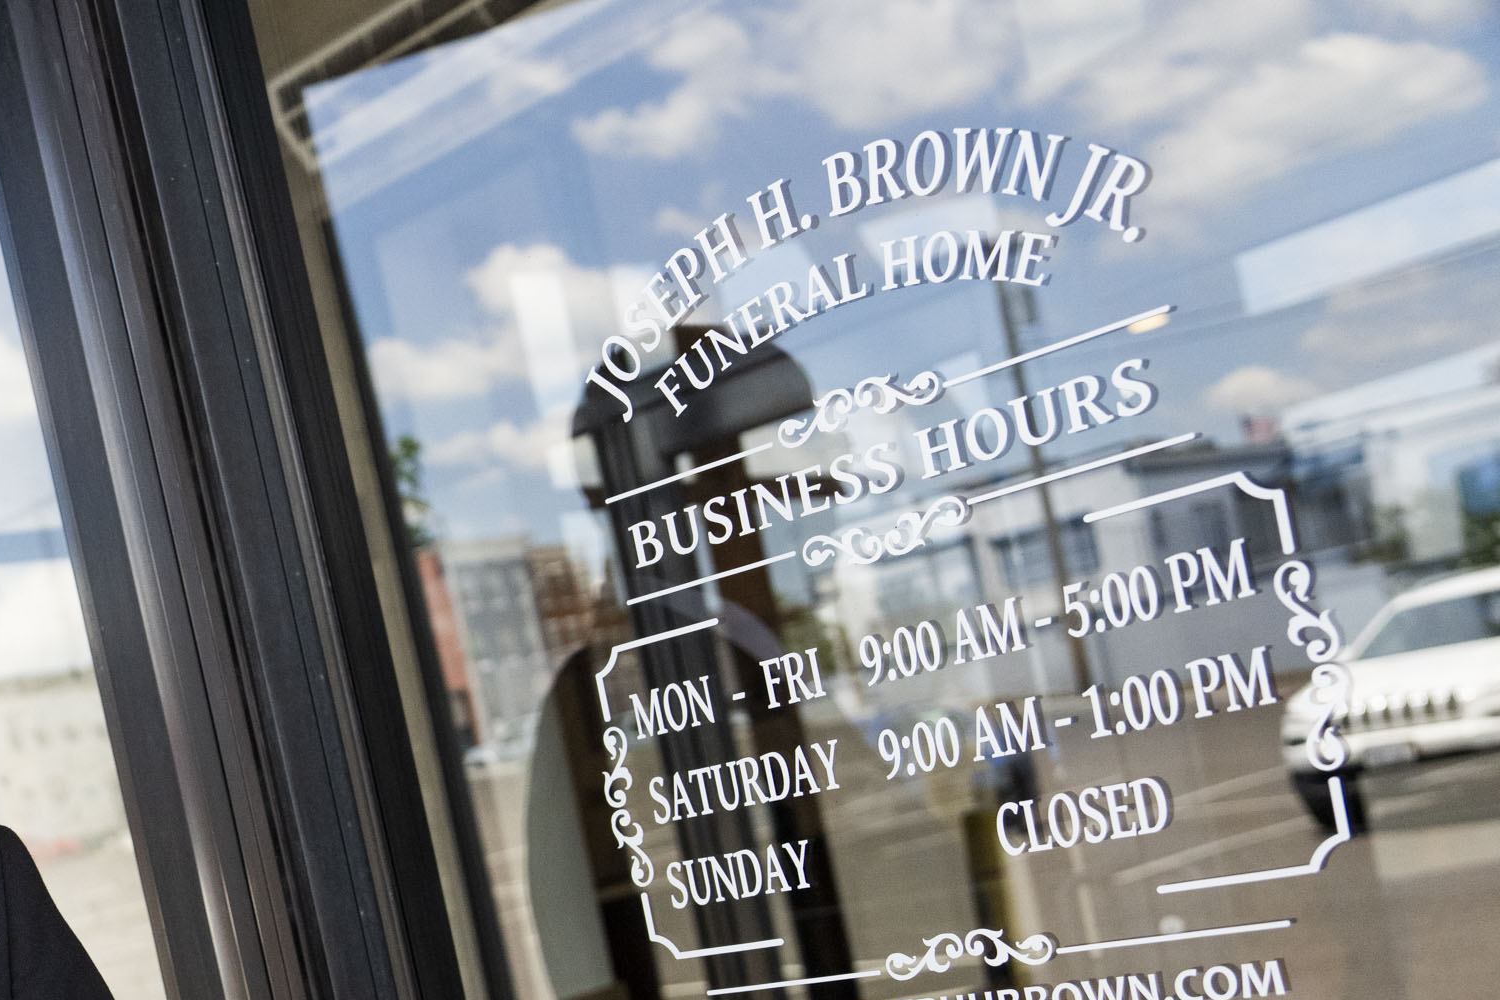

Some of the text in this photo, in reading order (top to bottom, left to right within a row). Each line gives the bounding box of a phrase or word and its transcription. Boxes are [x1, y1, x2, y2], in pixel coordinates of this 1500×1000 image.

[586, 128, 1148, 422] JOSEPH H. BROWN JR.
[654, 230, 1055, 419] FUNERAL HOME
[628, 358, 1154, 569] BUSINESS HOURS
[629, 675, 714, 740] MON
[759, 648, 826, 710] FRI
[859, 620, 941, 687] 9:00
[953, 597, 1026, 666] AM
[1062, 565, 1157, 638] 5:00
[1164, 538, 1256, 614] PM
[648, 740, 840, 825] SATURDAY
[878, 717, 961, 781] 9:00
[972, 695, 1046, 763] AM
[1082, 669, 1181, 739] 1:00
[1186, 645, 1278, 719] PM
[665, 777, 1168, 909] SUNDAY CLOSED
